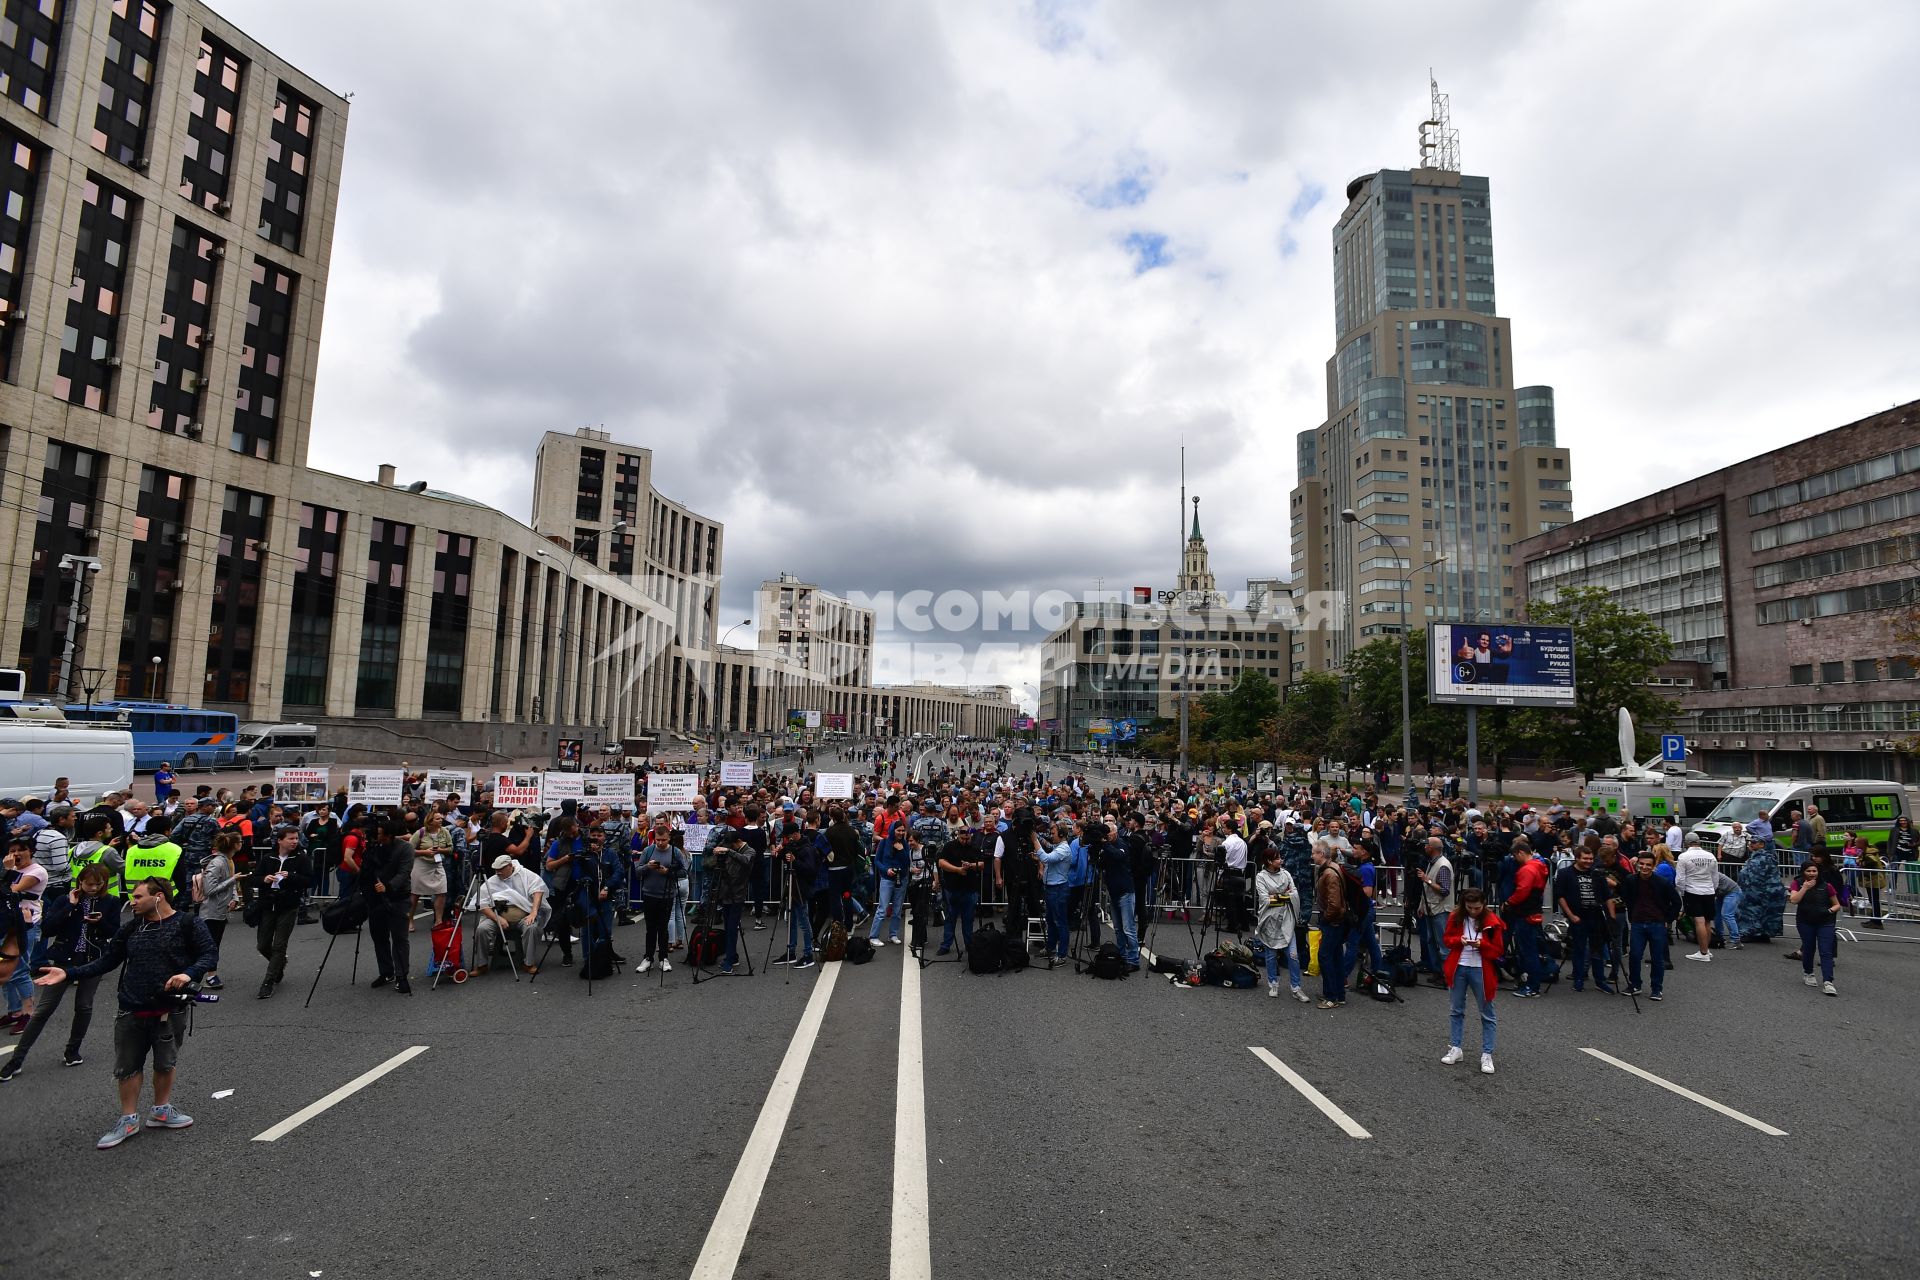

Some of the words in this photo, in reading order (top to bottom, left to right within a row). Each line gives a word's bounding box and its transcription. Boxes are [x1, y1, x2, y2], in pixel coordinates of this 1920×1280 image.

[1158, 590, 1220, 601] РОСБАНК
[1458, 666, 1471, 677] 6+
[1667, 738, 1680, 758] P
[499, 787, 538, 796] ТУЛЬСКАЯ
[1588, 785, 1623, 793] TELEVISION
[1811, 787, 1854, 795] TELEVISION
[498, 796, 538, 805] ПРАВДА!
[133, 859, 166, 868] PRESS
